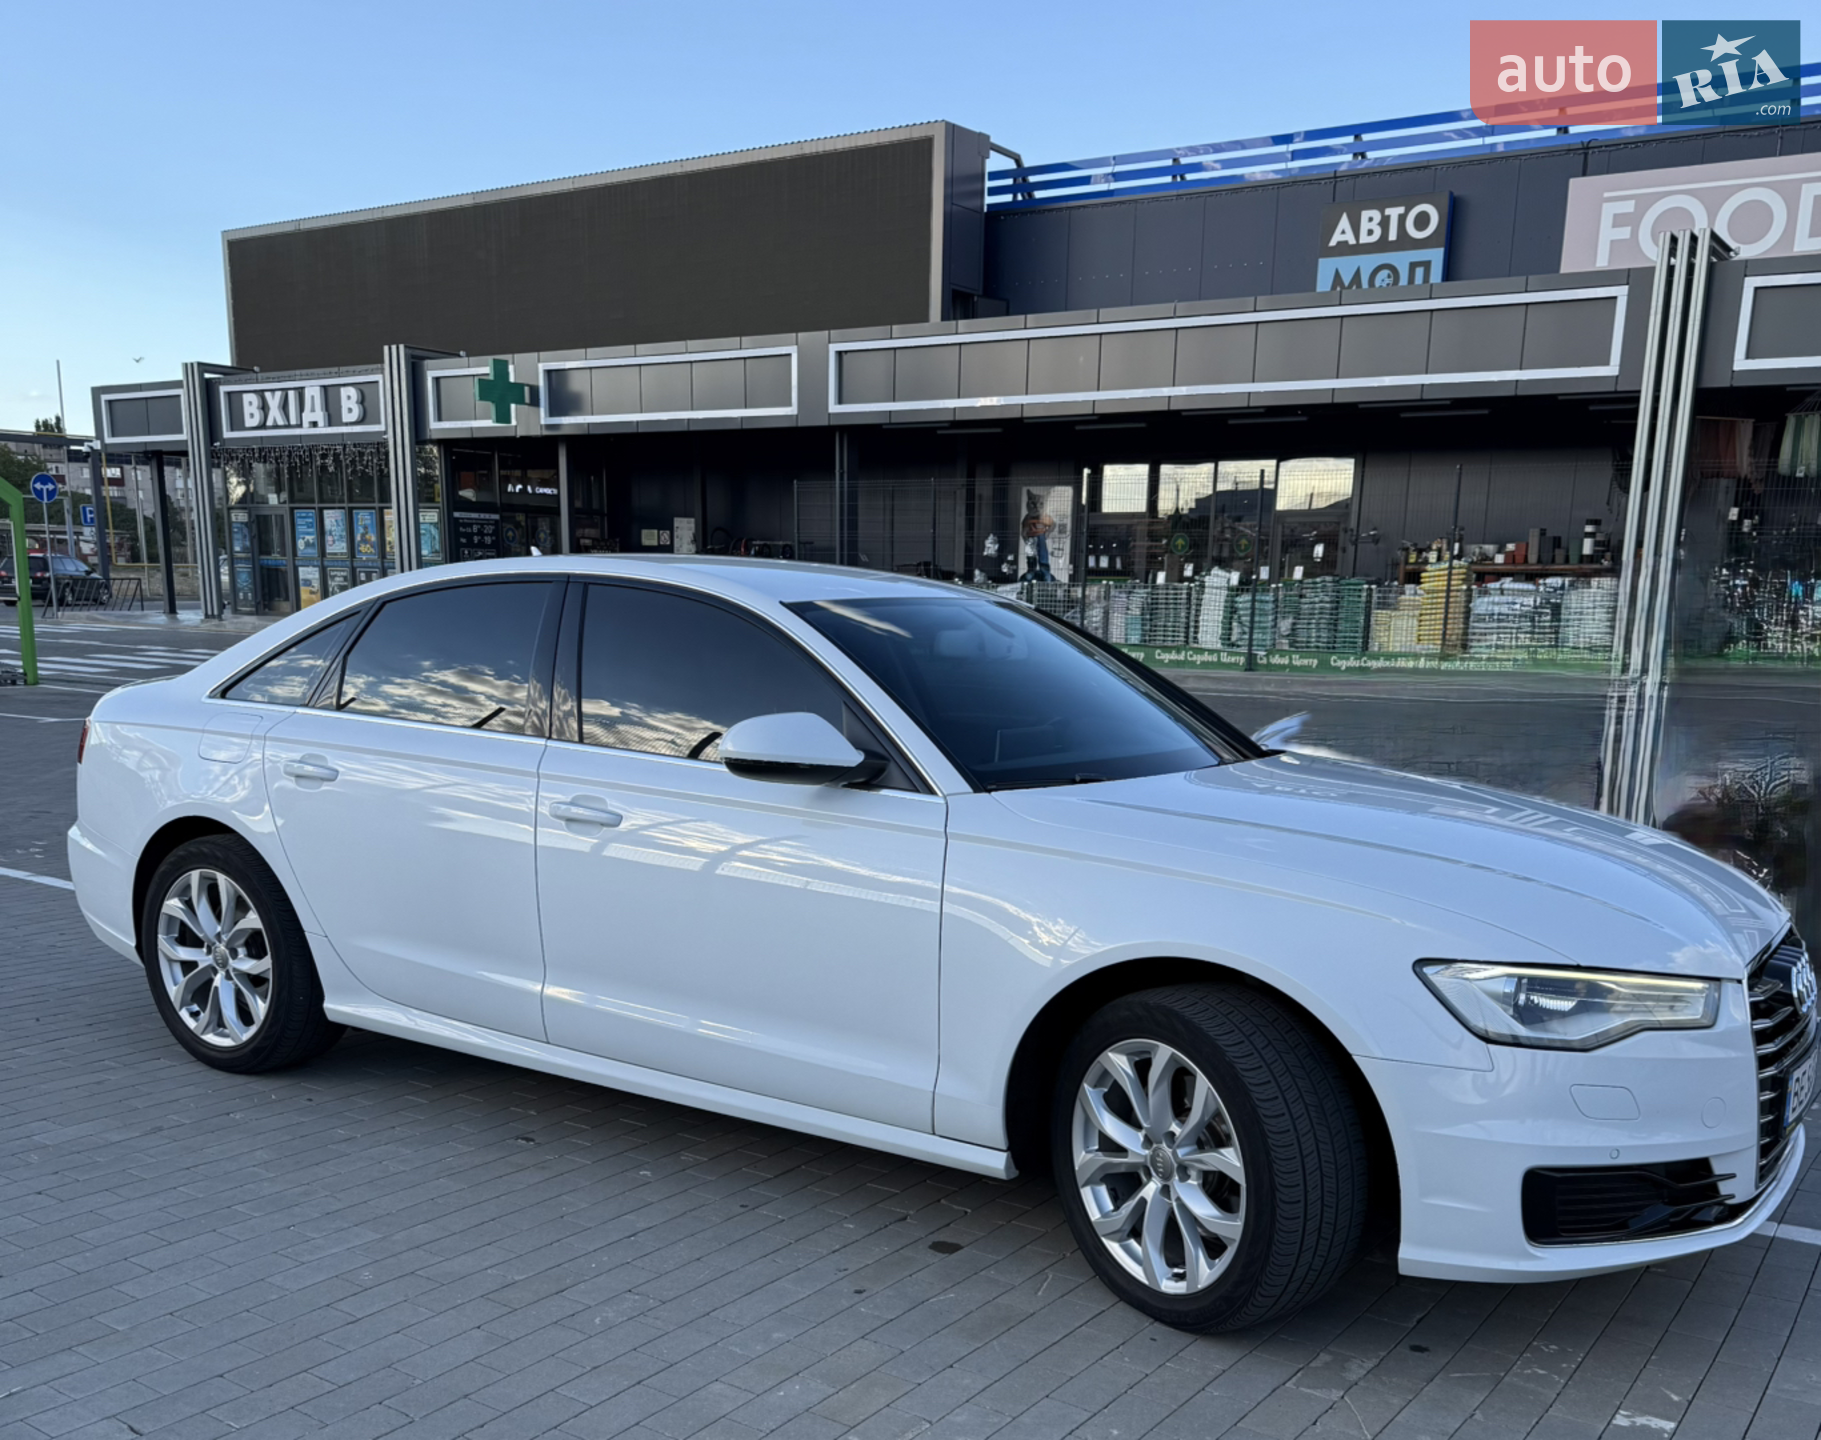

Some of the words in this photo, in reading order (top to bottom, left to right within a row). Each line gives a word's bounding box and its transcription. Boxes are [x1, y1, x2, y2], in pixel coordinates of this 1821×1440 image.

[1328, 203, 1440, 247] АВТО
[242, 386, 329, 428] ВХІД
[340, 386, 364, 423] В
